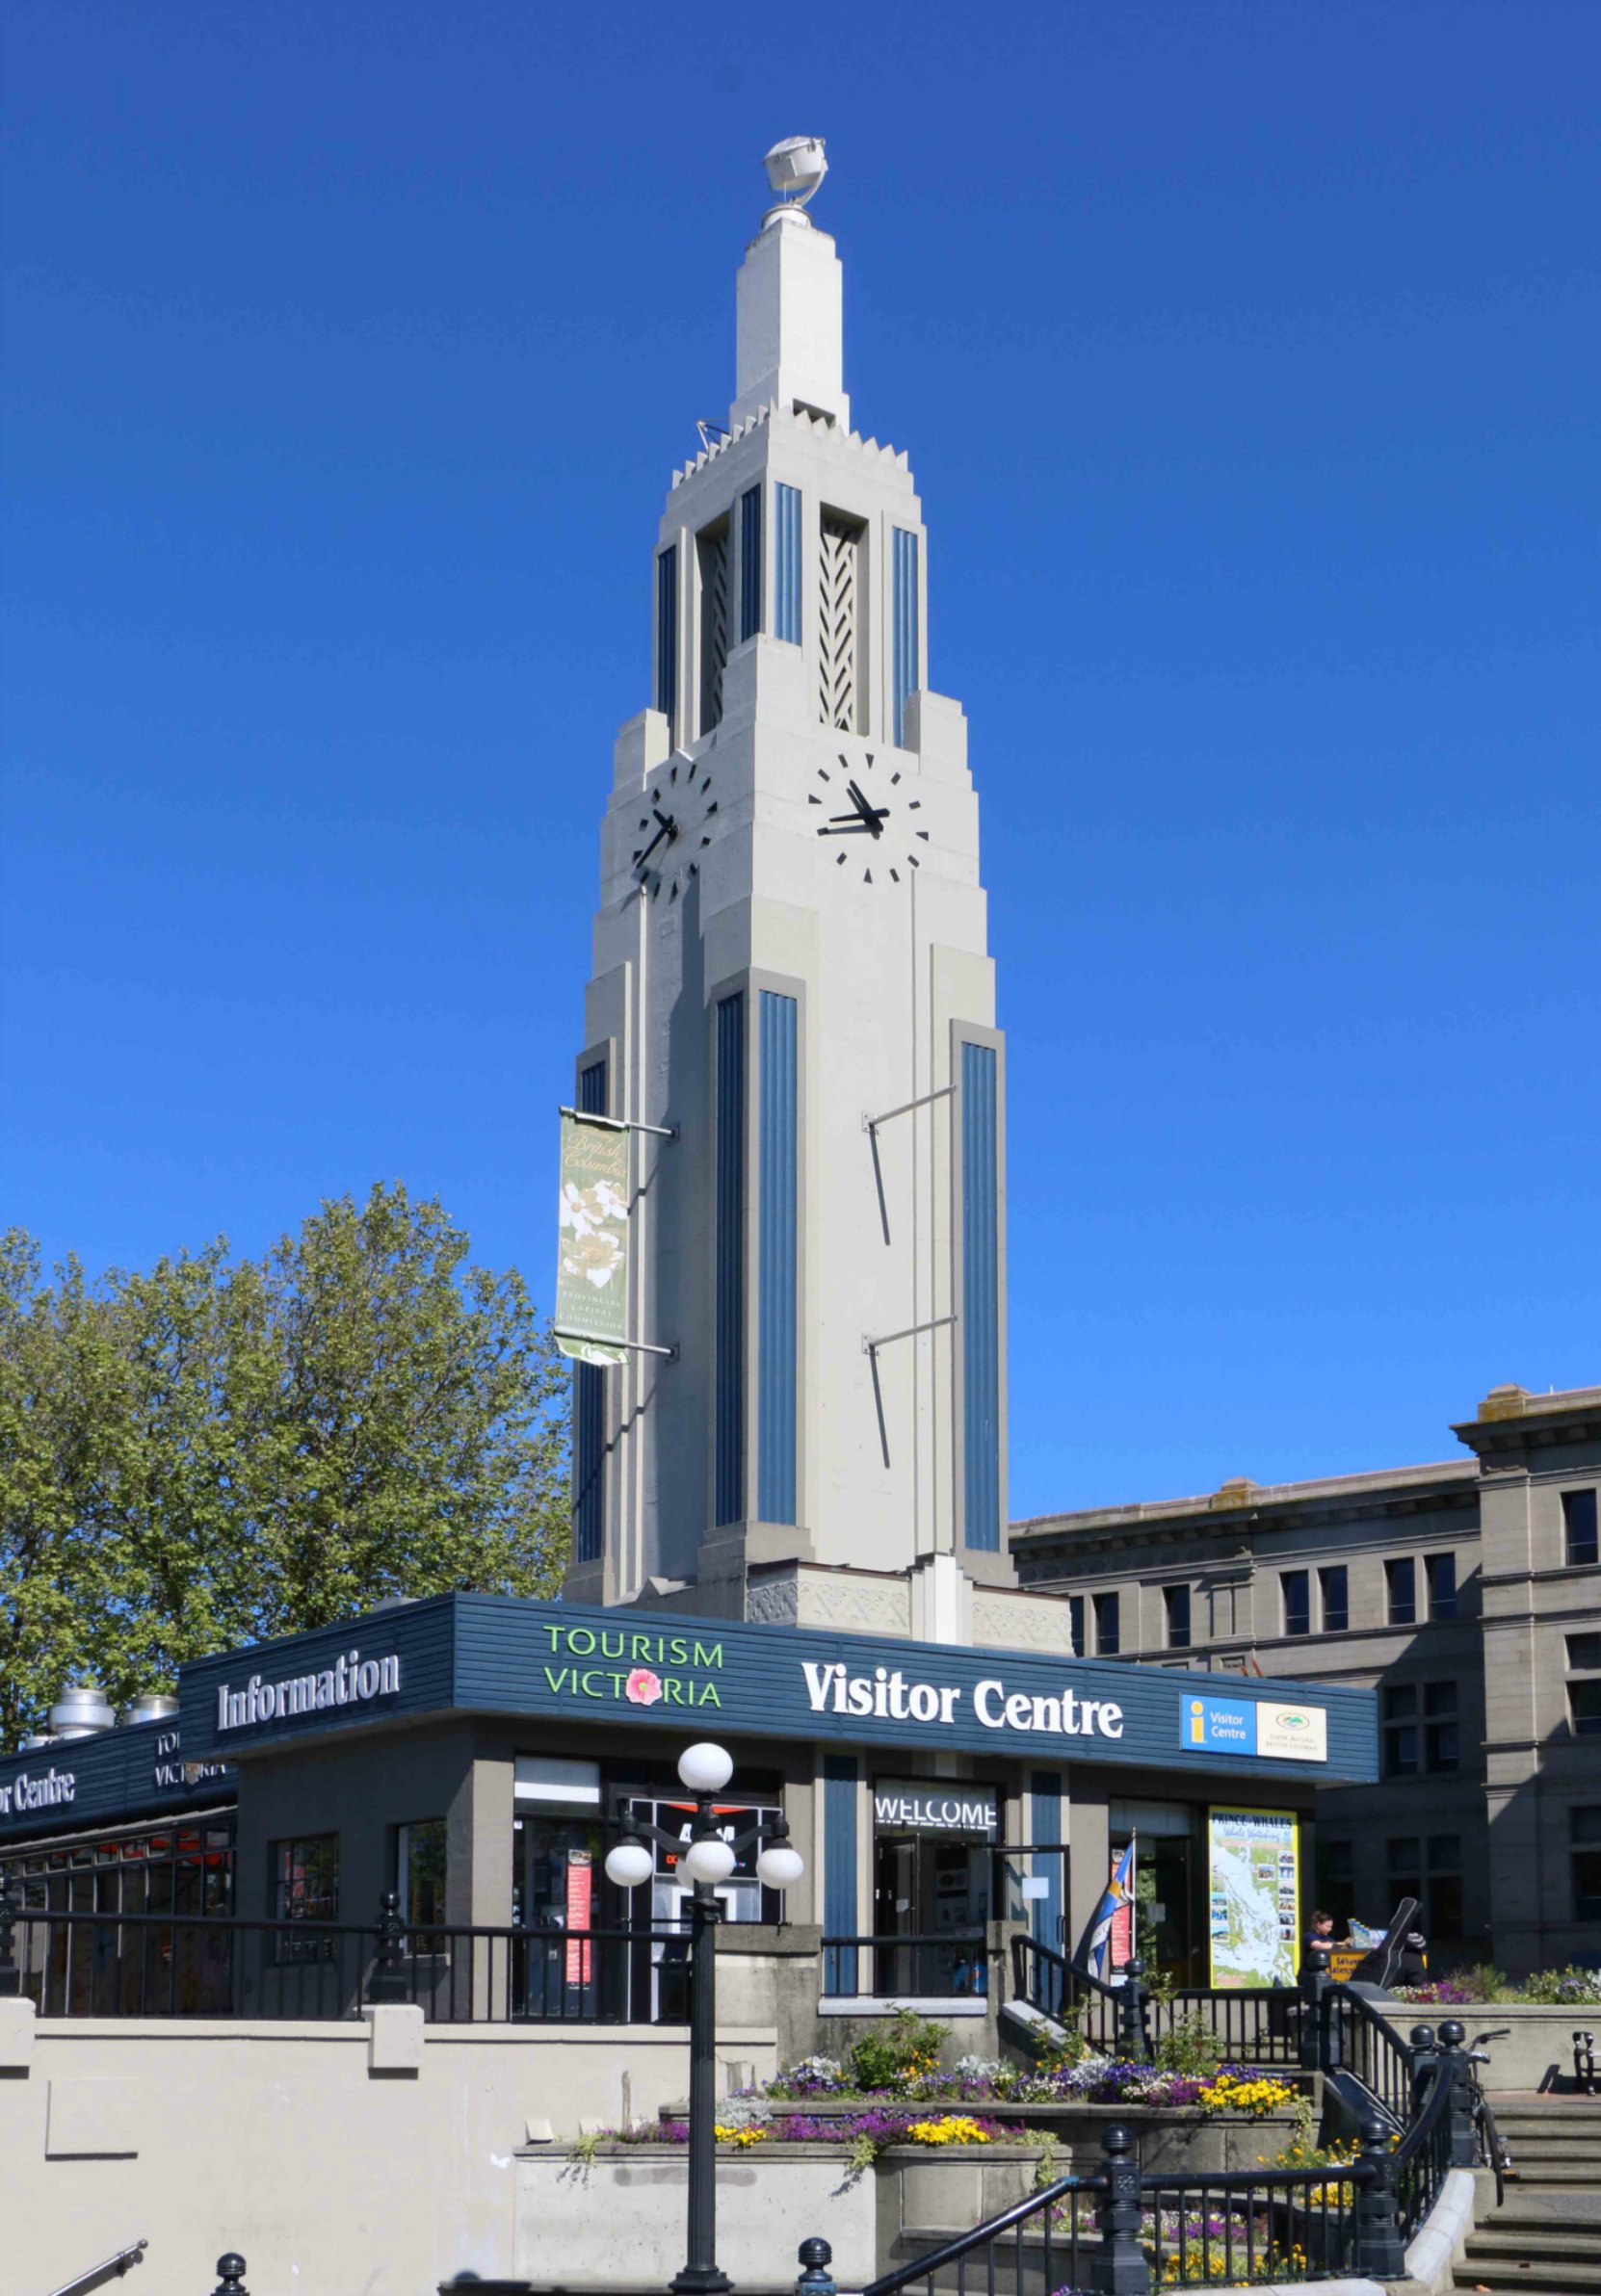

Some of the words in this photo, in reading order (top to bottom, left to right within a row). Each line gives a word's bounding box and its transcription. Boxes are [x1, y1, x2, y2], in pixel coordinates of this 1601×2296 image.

[543, 1625, 722, 1670] TOURISM
[218, 1650, 400, 1731] Information
[801, 1662, 960, 1724] Visitor
[973, 1680, 1123, 1738] Centre
[1210, 1711, 1244, 1725] Visitor
[1211, 1726, 1247, 1739] Centre
[14, 1768, 75, 1812] Centre
[875, 1796, 998, 1826] WELCOME
[1212, 1813, 1247, 1827] PRINCE
[1253, 1816, 1293, 1829] WHALES
